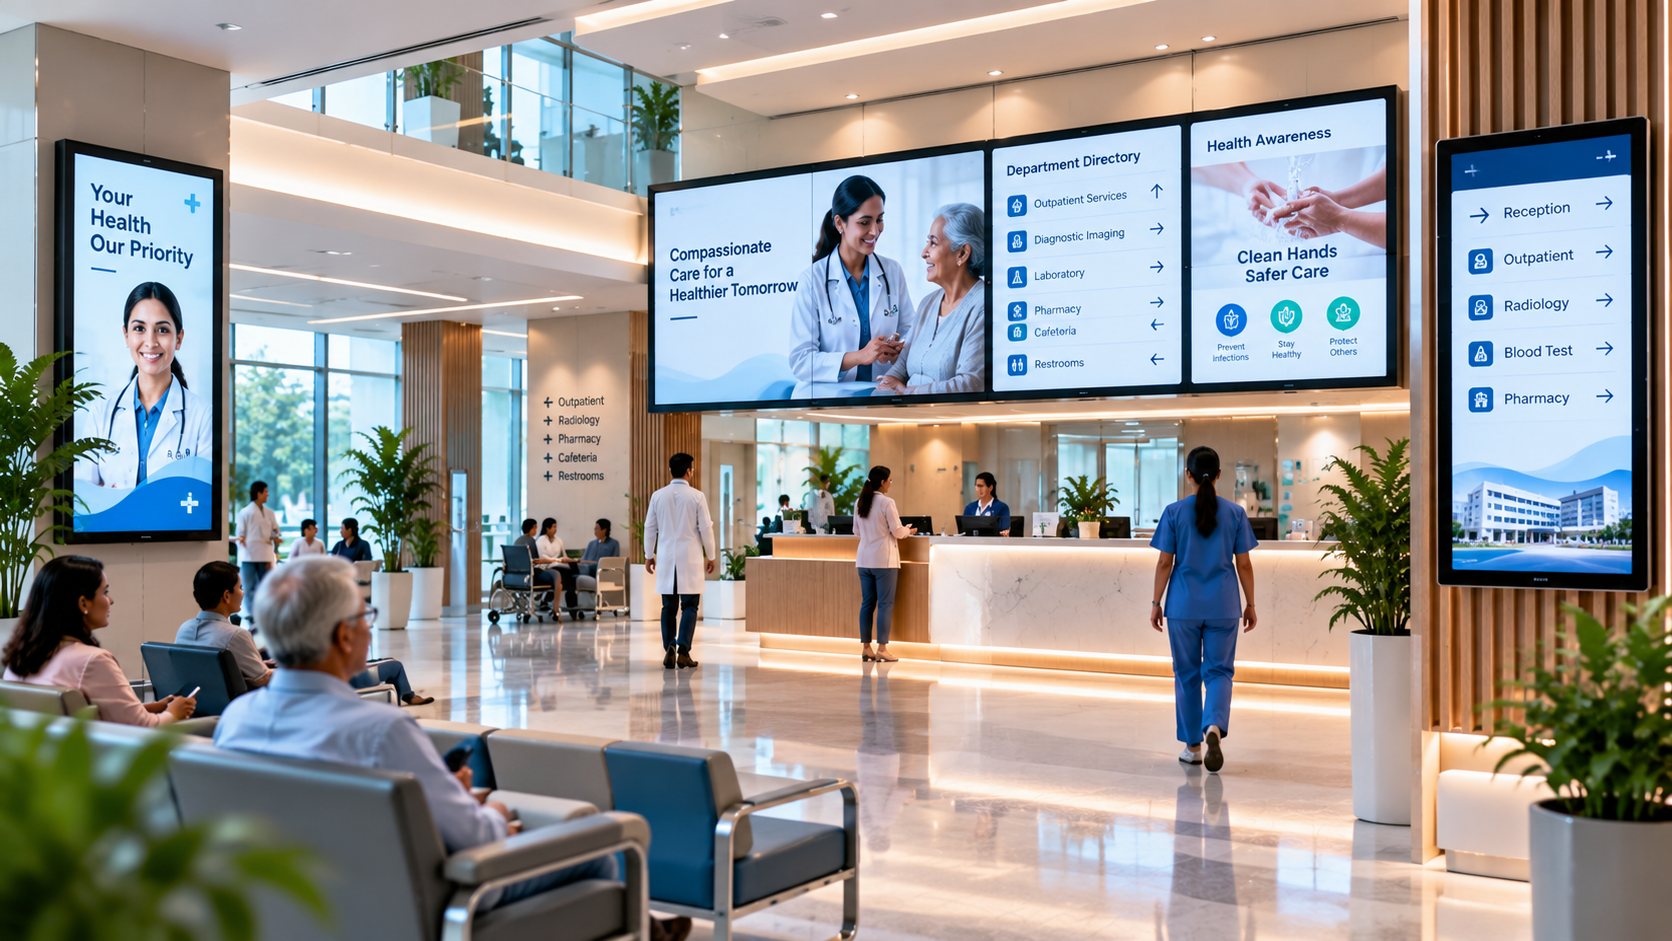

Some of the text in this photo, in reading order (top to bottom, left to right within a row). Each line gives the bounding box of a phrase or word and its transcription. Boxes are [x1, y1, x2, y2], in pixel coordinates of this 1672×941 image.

[1208, 129, 1331, 152] Health Awareness
[1007, 153, 1140, 177] Department Directory
[91, 183, 133, 206] Your
[1033, 191, 1128, 209] Outpatient Services
[1504, 203, 1570, 218] Reception
[91, 208, 150, 234] Health
[1034, 228, 1125, 246] Diagnostic Imaging
[91, 234, 193, 269] Our Priority
[670, 240, 771, 262] Compassionate
[1238, 244, 1337, 264] Clean Hands
[1504, 250, 1573, 266] Outpatient
[670, 265, 734, 282] Care for a
[1034, 269, 1086, 281] Laboratory
[1246, 265, 1330, 282] Safer Care
[670, 282, 798, 302] Healthier Tomorrow
[1034, 305, 1082, 316] Pharmacy
[1504, 297, 1570, 312] Radiology
[1217, 343, 1246, 352] Prevent
[1277, 339, 1296, 349] Stay
[1329, 337, 1358, 346] Protect
[1271, 349, 1302, 360] Healthy
[1329, 347, 1358, 357] Others
[1504, 344, 1574, 359] Blood Test
[1034, 359, 1085, 369] Restrooms
[558, 395, 605, 409] Outpatient
[1504, 392, 1570, 407] Pharmacy
[558, 414, 601, 427] Radiology
[558, 433, 602, 446] Pharmacy
[557, 451, 598, 463] Cafeteria
[558, 470, 605, 482] Restrooms
